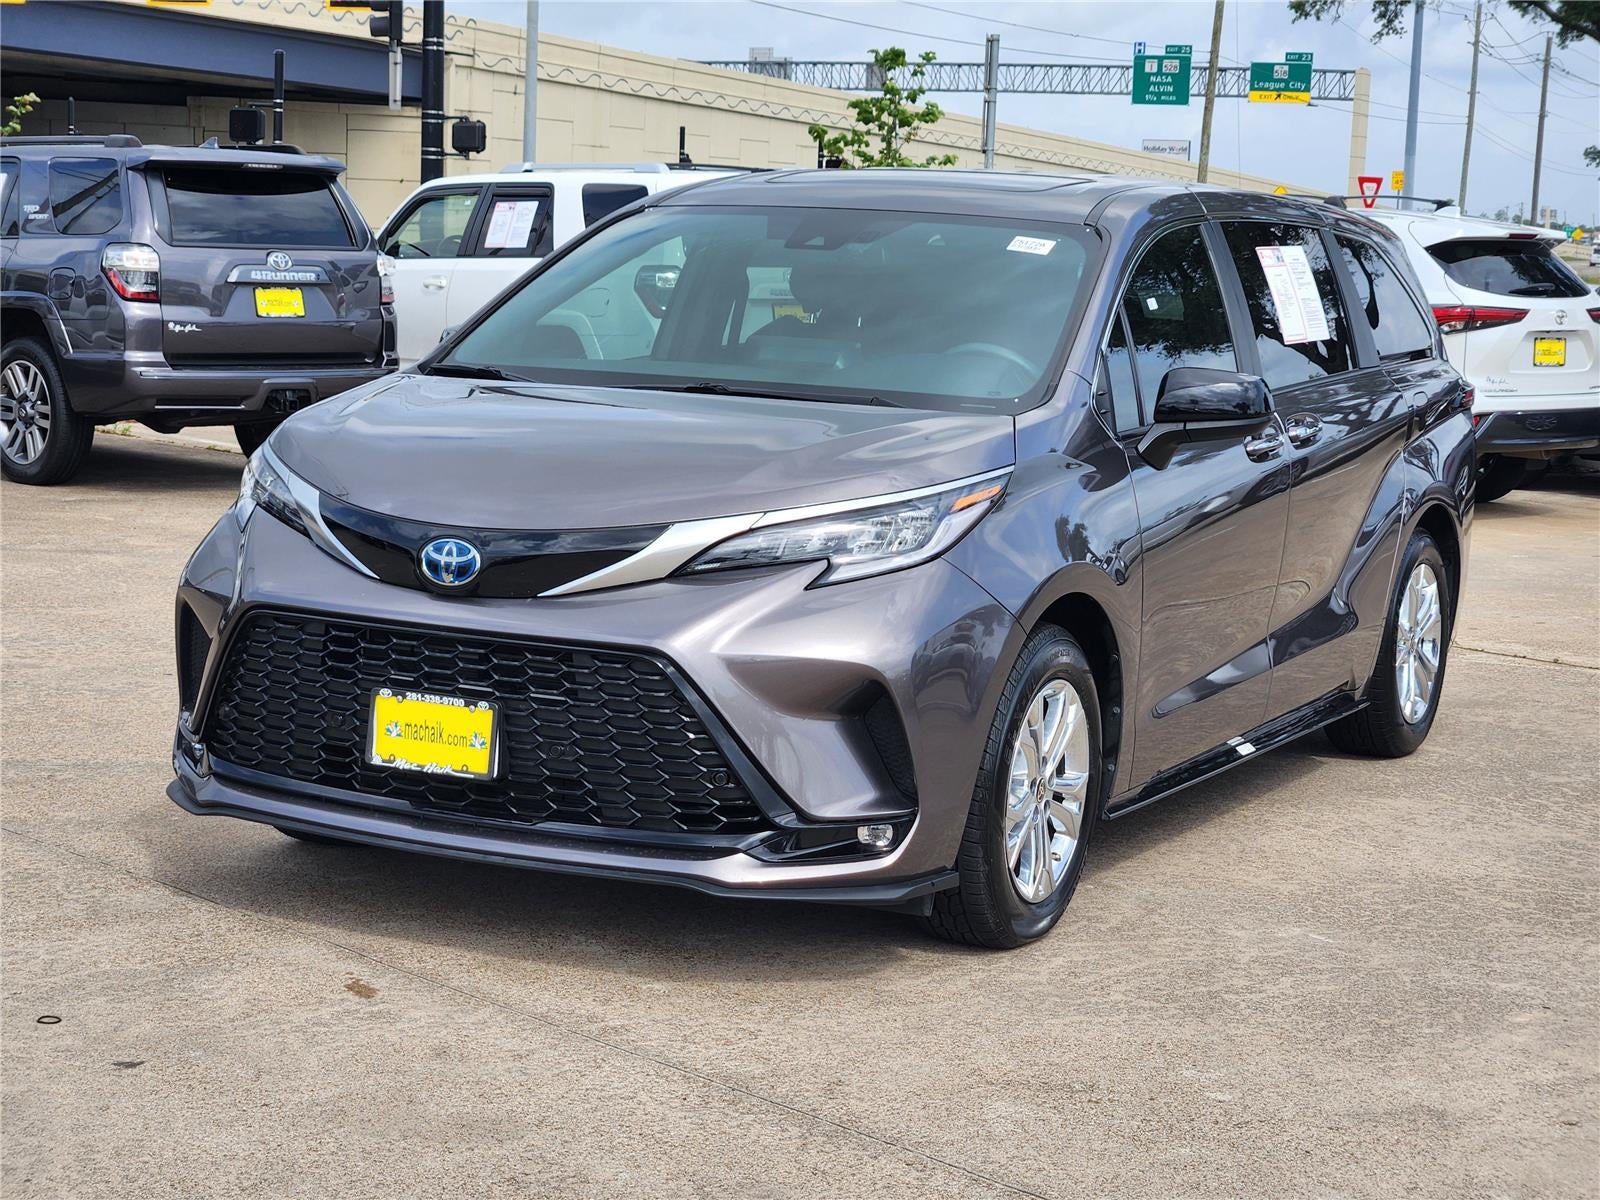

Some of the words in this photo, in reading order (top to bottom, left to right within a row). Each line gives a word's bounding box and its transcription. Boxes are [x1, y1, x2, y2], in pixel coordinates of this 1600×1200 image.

[1254, 81, 1285, 90] League
[1289, 81, 1306, 90] City
[250, 270, 316, 281] 4RUNNER
[404, 720, 468, 748] machaik.com
